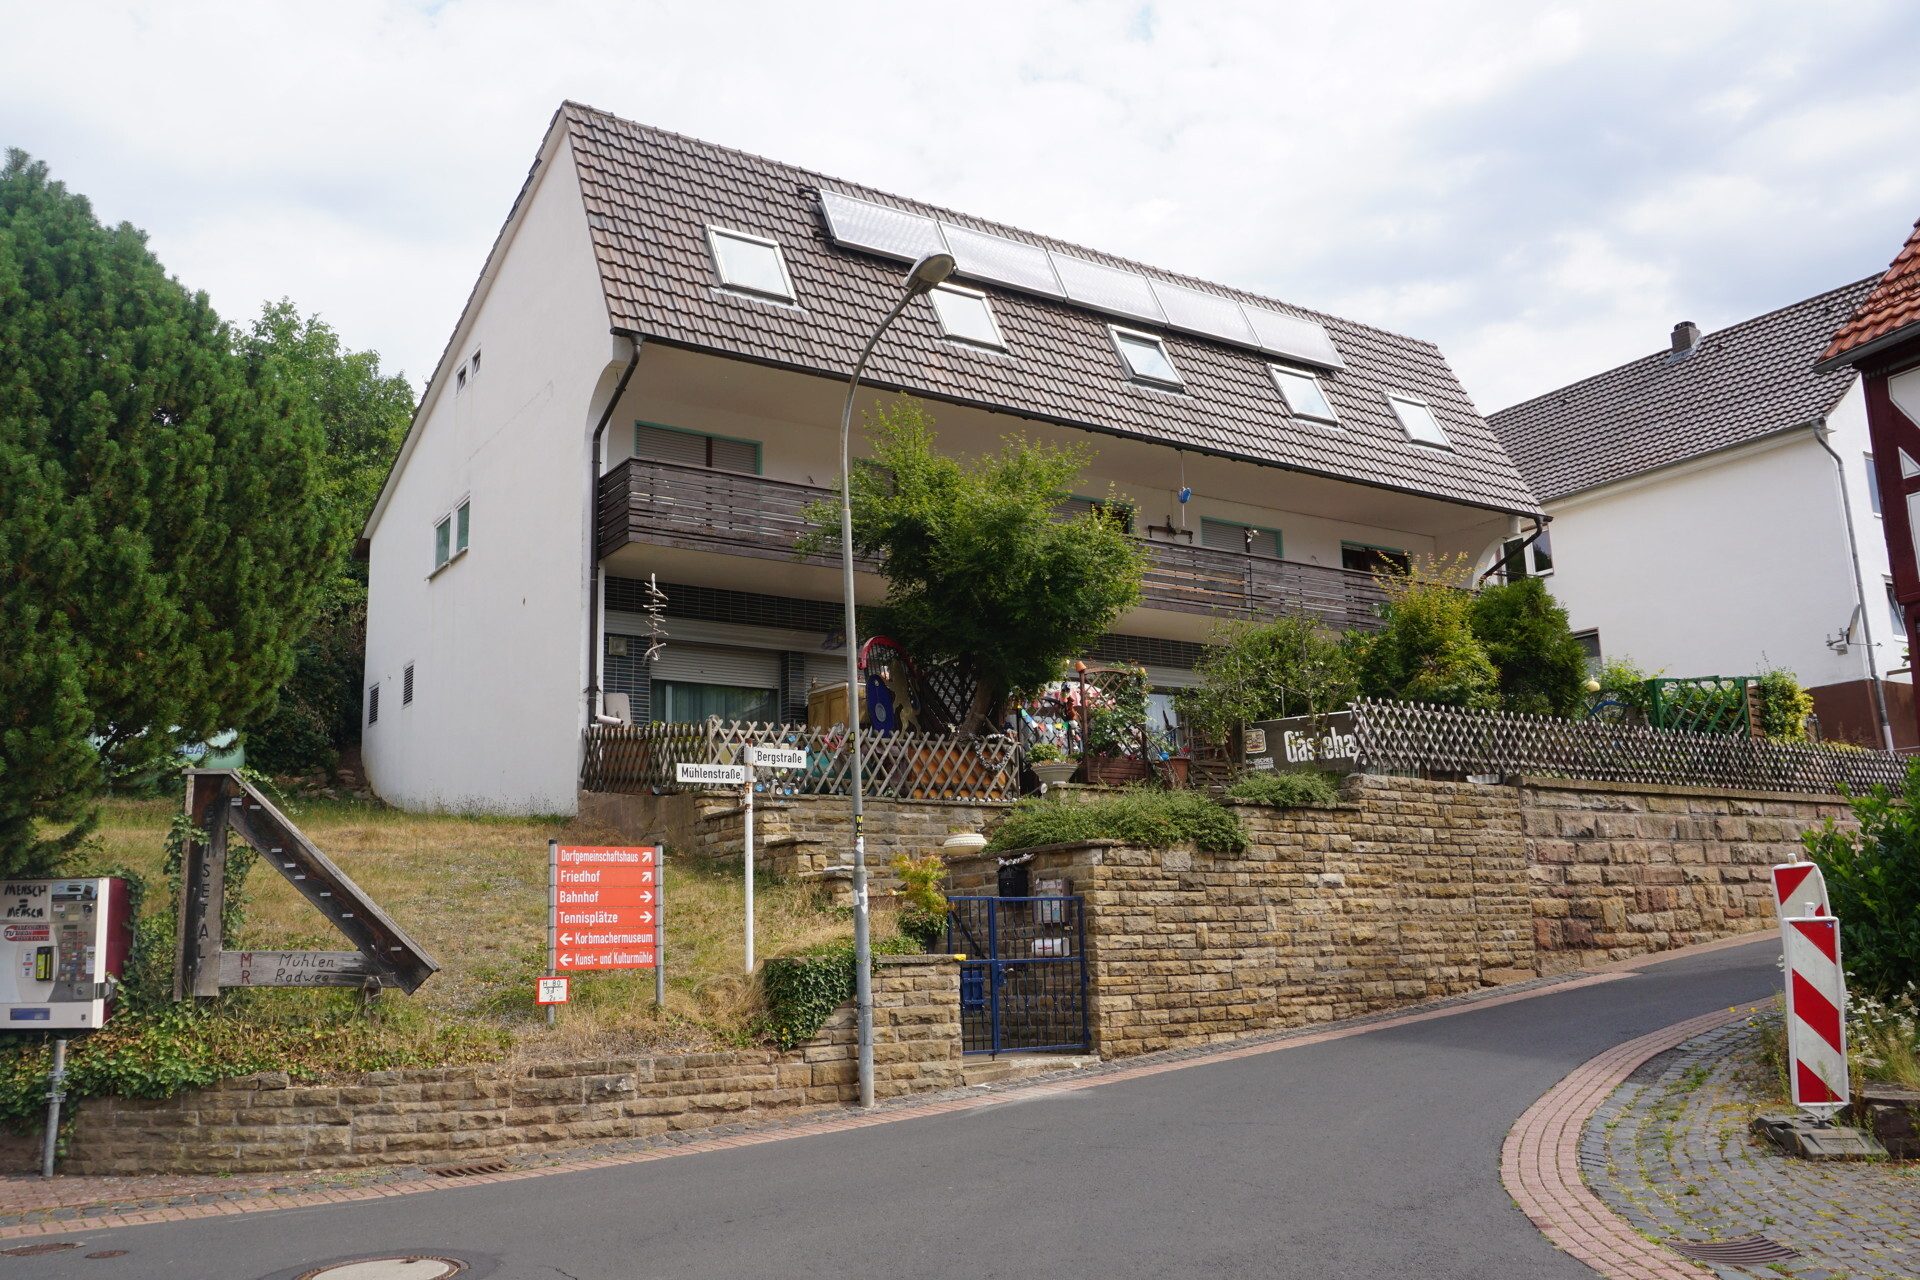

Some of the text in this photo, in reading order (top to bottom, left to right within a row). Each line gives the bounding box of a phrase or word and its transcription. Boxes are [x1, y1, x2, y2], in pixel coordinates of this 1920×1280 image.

[757, 750, 802, 765] Bergstraße
[681, 766, 741, 780] Mühlenstraße
[561, 849, 639, 865] Dorfgemeinschaftshaus
[560, 870, 601, 882] Friedhof
[559, 890, 600, 903] Bahnhof
[559, 911, 618, 926] Tennisplätze
[575, 932, 653, 945] Korbmachermuseum
[575, 951, 653, 966] Kunst- und Kulturmühle
